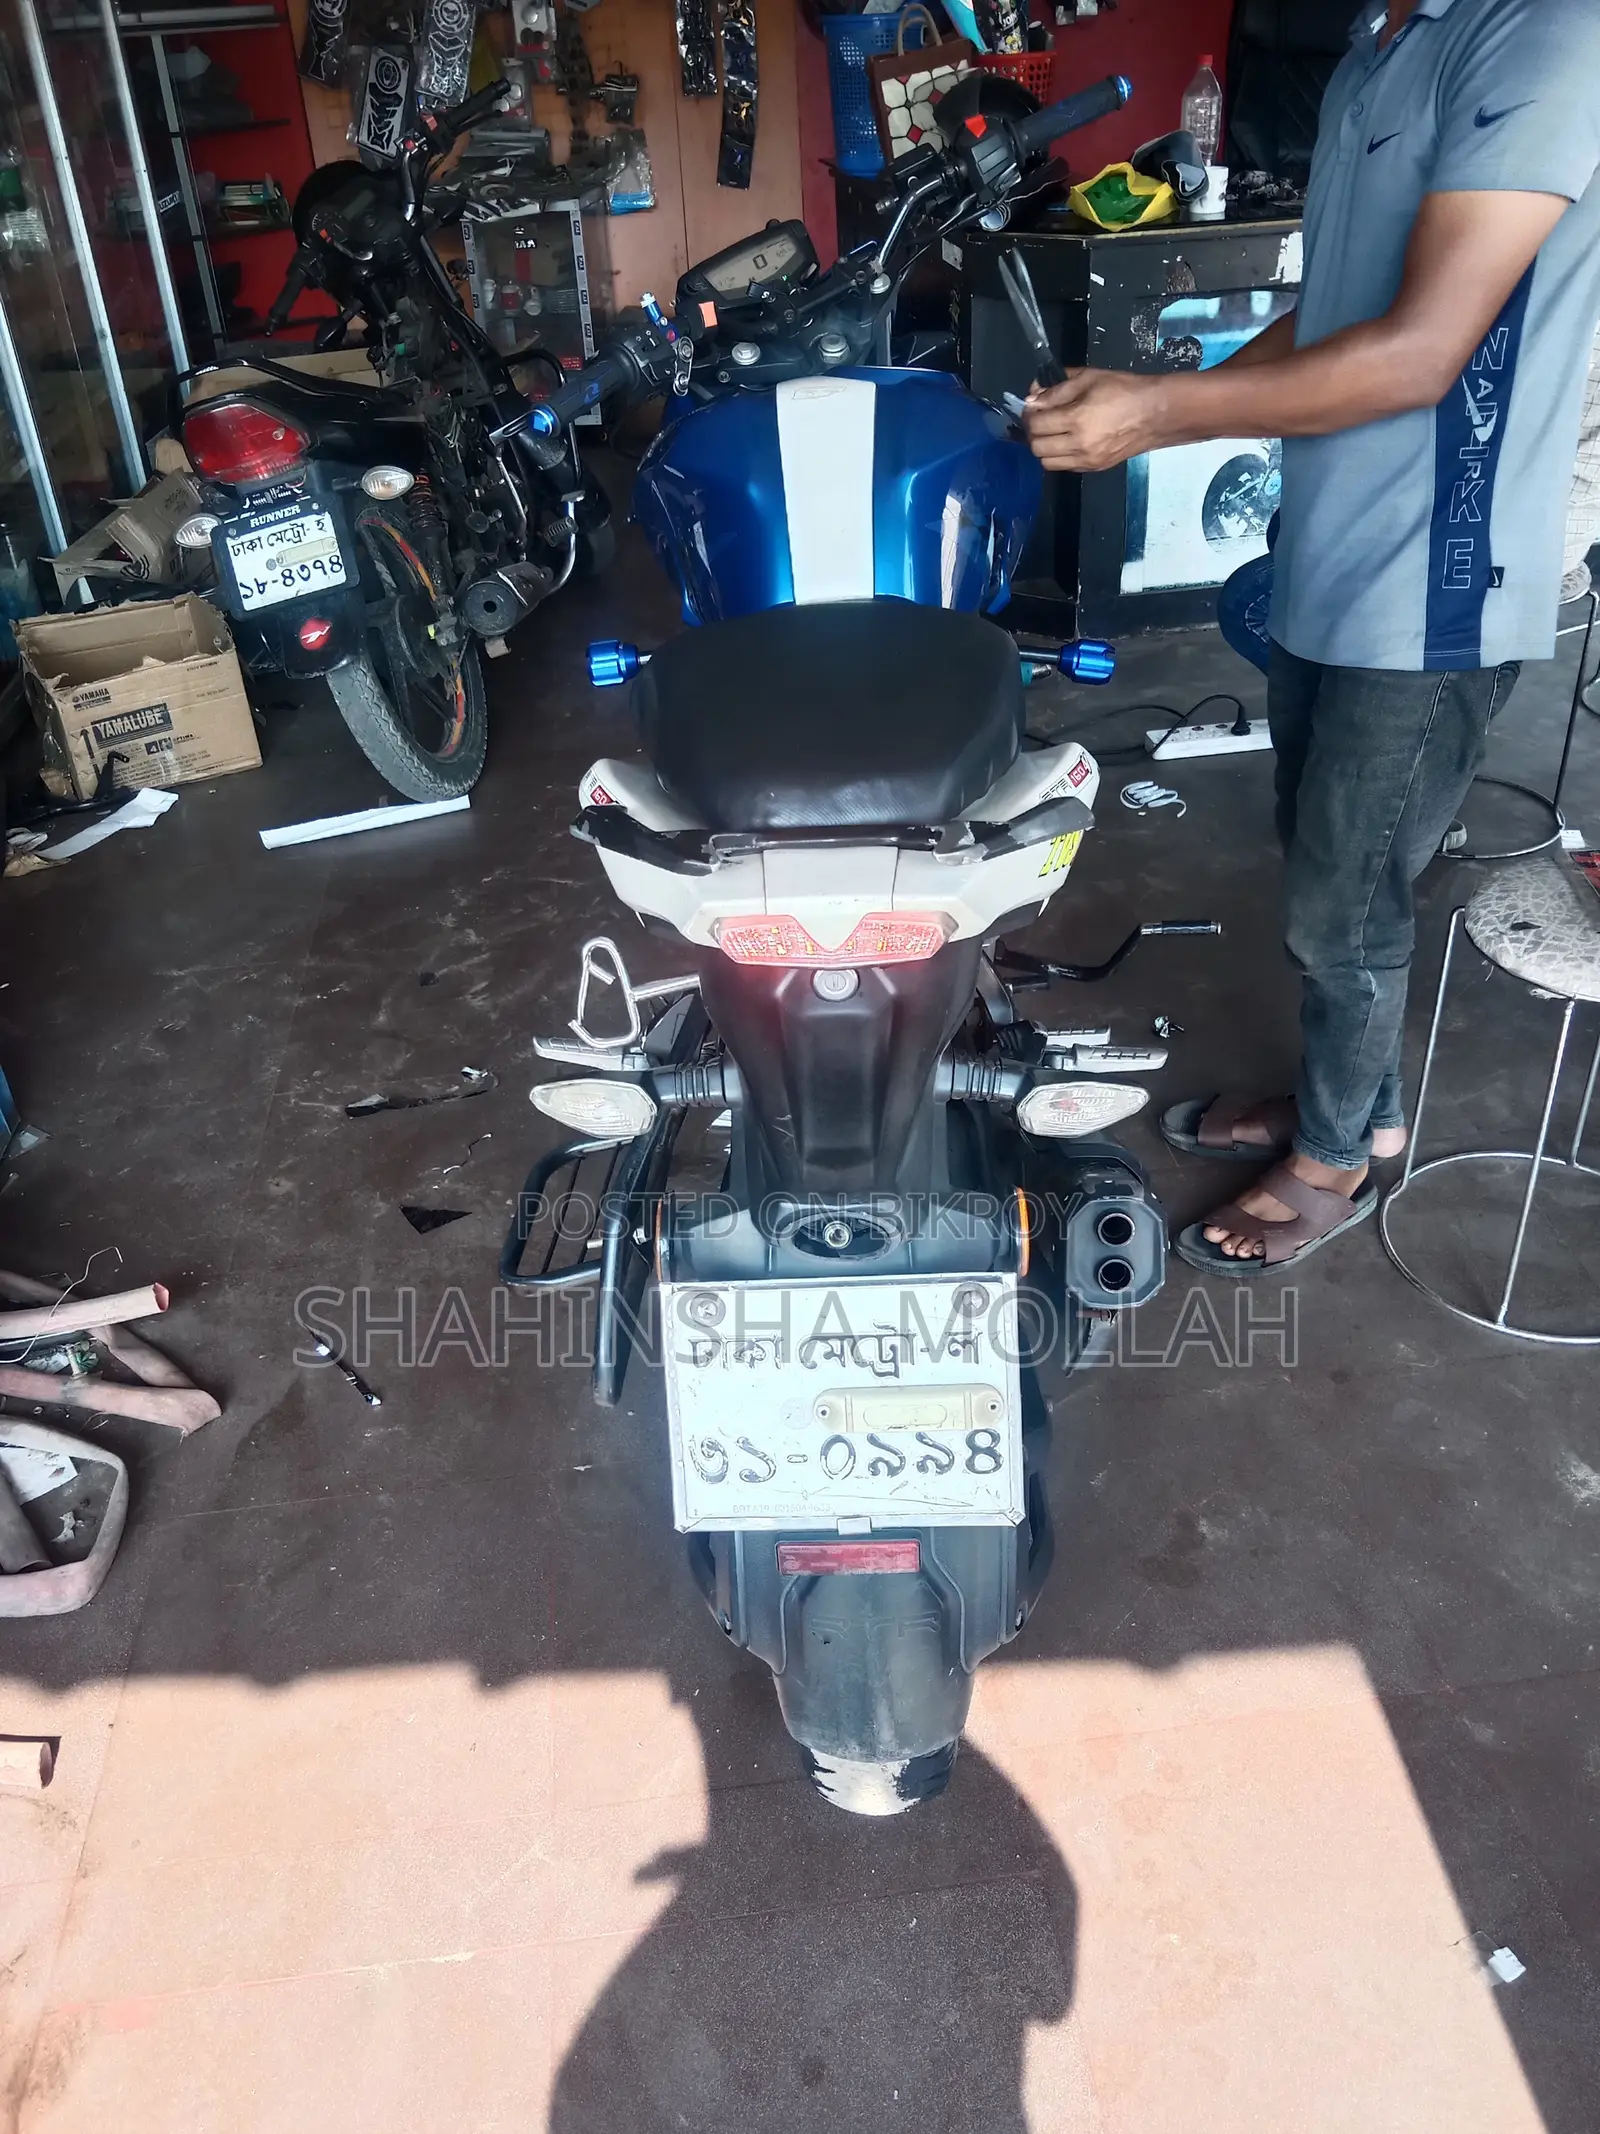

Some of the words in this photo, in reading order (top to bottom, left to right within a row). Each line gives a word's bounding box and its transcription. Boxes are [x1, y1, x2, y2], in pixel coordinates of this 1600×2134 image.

[249, 504, 302, 529] RUNNER
[230, 534, 264, 558] ঢাকা
[239, 554, 344, 600] ১৮-৪৩৭৪
[79, 687, 110, 702] YAMAHA
[96, 707, 166, 741] YAMALUBE
[687, 1335, 784, 1370] ঢাকা
